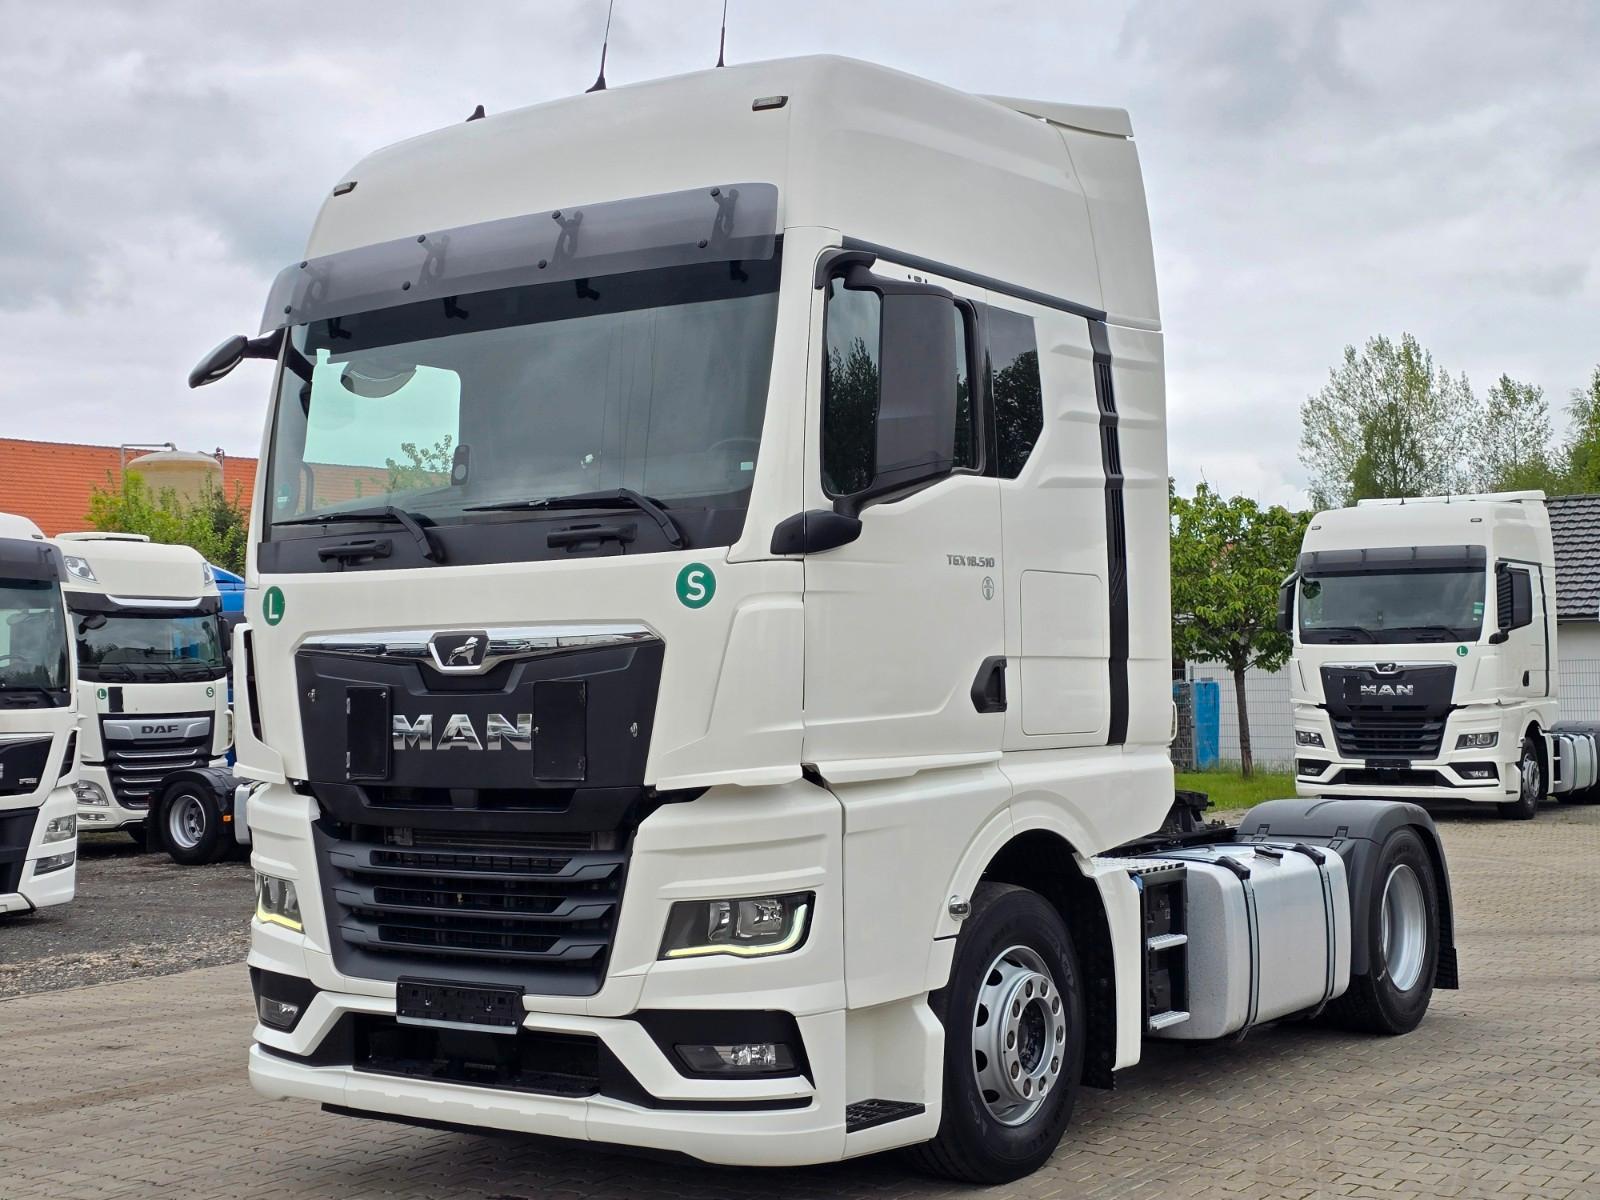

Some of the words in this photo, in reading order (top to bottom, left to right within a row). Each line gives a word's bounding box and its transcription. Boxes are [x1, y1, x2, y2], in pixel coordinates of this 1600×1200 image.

[686, 570, 706, 601] S
[268, 593, 280, 619] L
[1360, 684, 1414, 696] MAN
[141, 725, 179, 734] DAF
[392, 713, 533, 751] MAN
